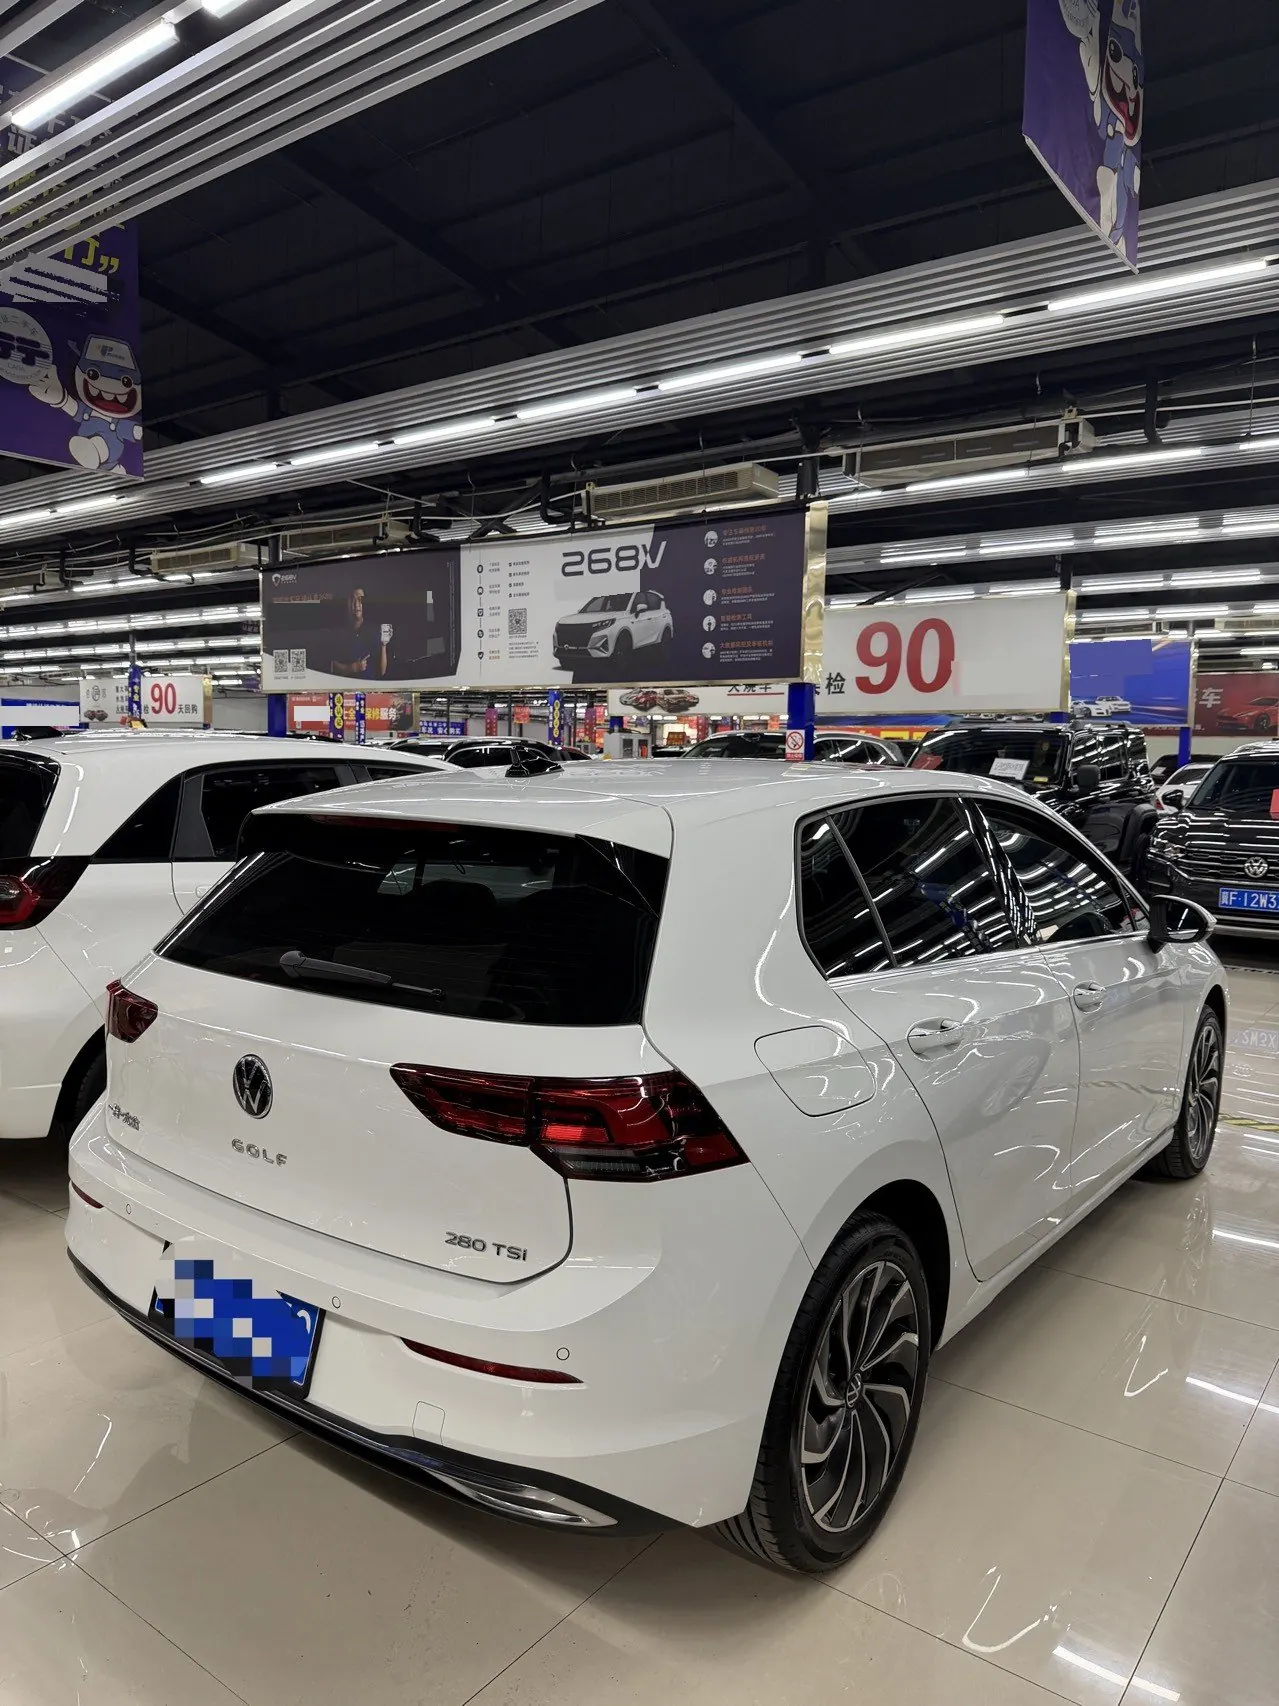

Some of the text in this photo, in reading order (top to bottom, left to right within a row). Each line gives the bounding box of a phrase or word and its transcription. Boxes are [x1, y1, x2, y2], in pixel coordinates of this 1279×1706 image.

[561, 541, 667, 577] 268V
[855, 617, 956, 695] 90
[151, 683, 177, 714] 90
[231, 1138, 288, 1167] GOLF
[445, 1231, 486, 1252] 280
